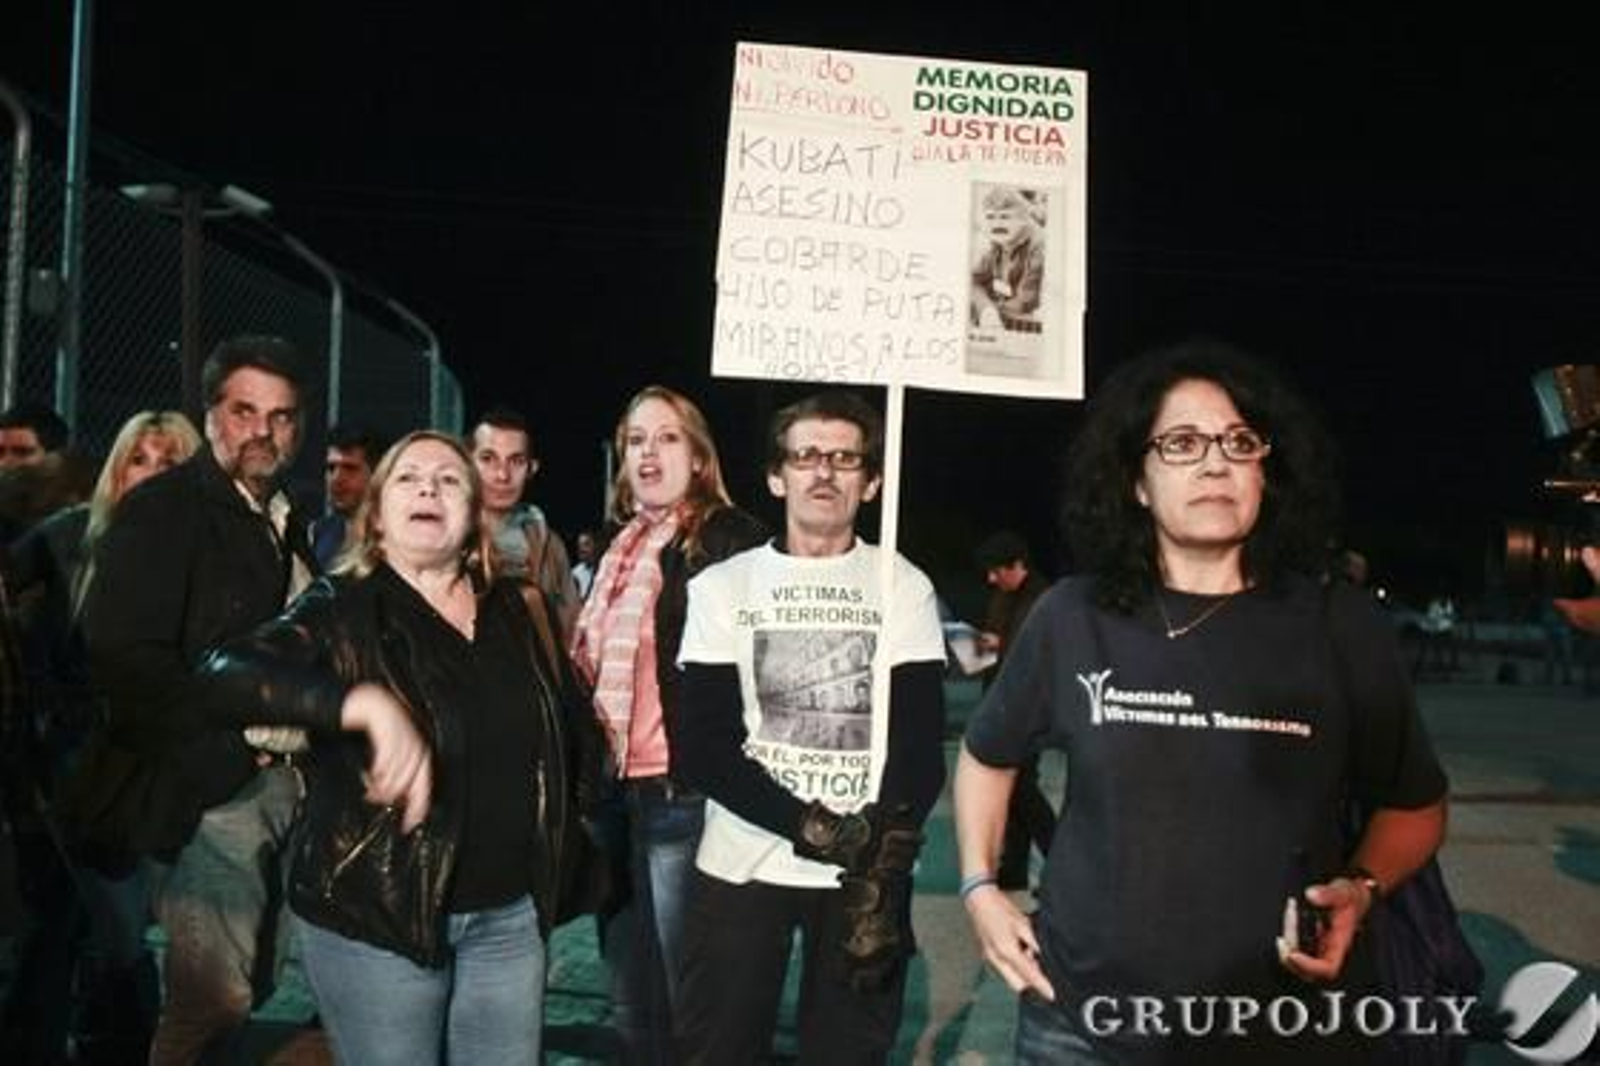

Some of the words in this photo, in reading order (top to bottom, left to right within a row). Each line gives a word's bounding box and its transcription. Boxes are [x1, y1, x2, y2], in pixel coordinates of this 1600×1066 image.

[916, 67, 1073, 97] MEMORIA
[913, 90, 1075, 121] DIGNIDAD
[922, 116, 1066, 148] JUSTICIA
[731, 181, 905, 229] ASESINO
[730, 236, 931, 283] COBARDE
[812, 284, 843, 313] DE
[863, 287, 955, 322] PUTA
[735, 608, 769, 628] DEL
